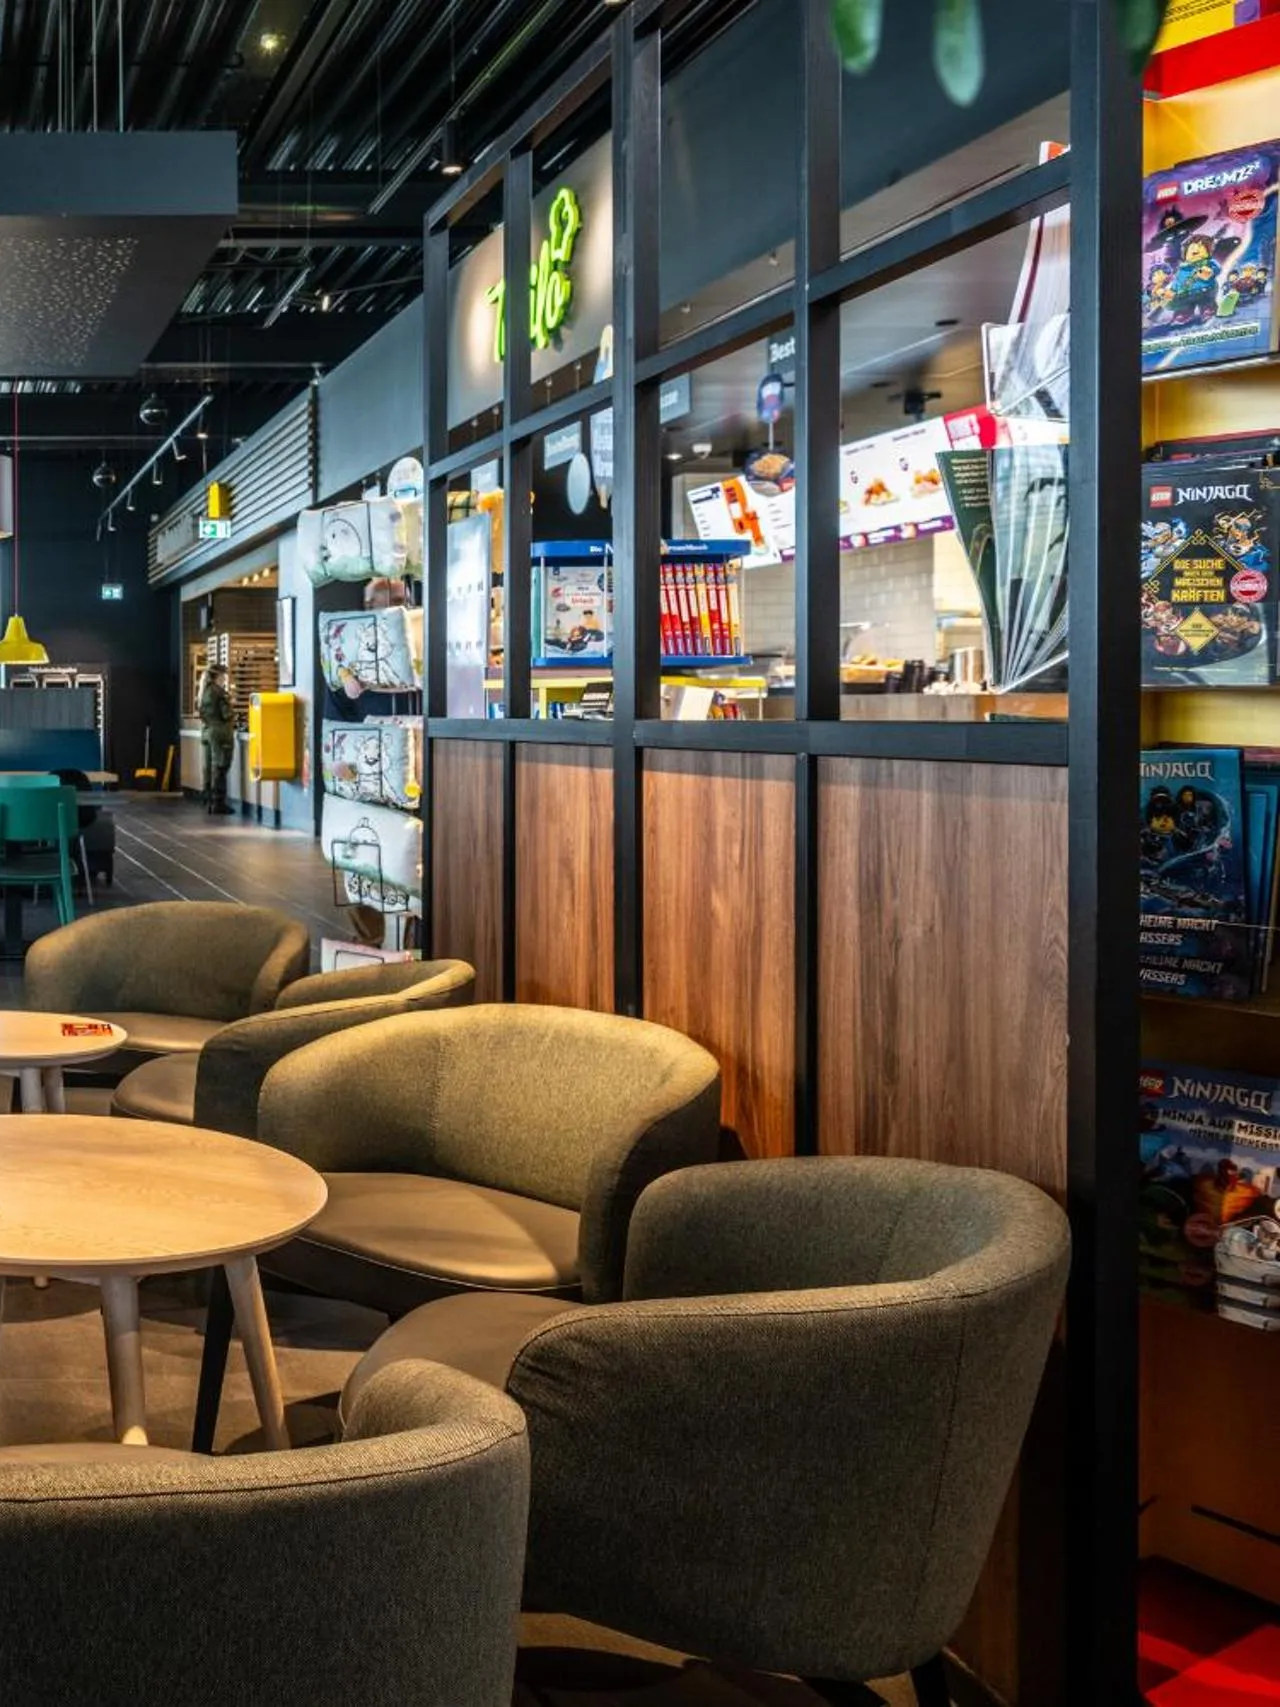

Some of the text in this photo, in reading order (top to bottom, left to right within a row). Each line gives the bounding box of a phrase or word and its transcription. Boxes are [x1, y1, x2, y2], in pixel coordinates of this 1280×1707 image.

[1175, 484, 1254, 506] NINJAGO
[1193, 558, 1224, 570] SUCHE
[1172, 588, 1224, 602] KRÄFTEN
[1169, 1077, 1271, 1117] NINJAGO
[1161, 1108, 1203, 1126] NINJA
[1237, 1122, 1280, 1140] MISSI
